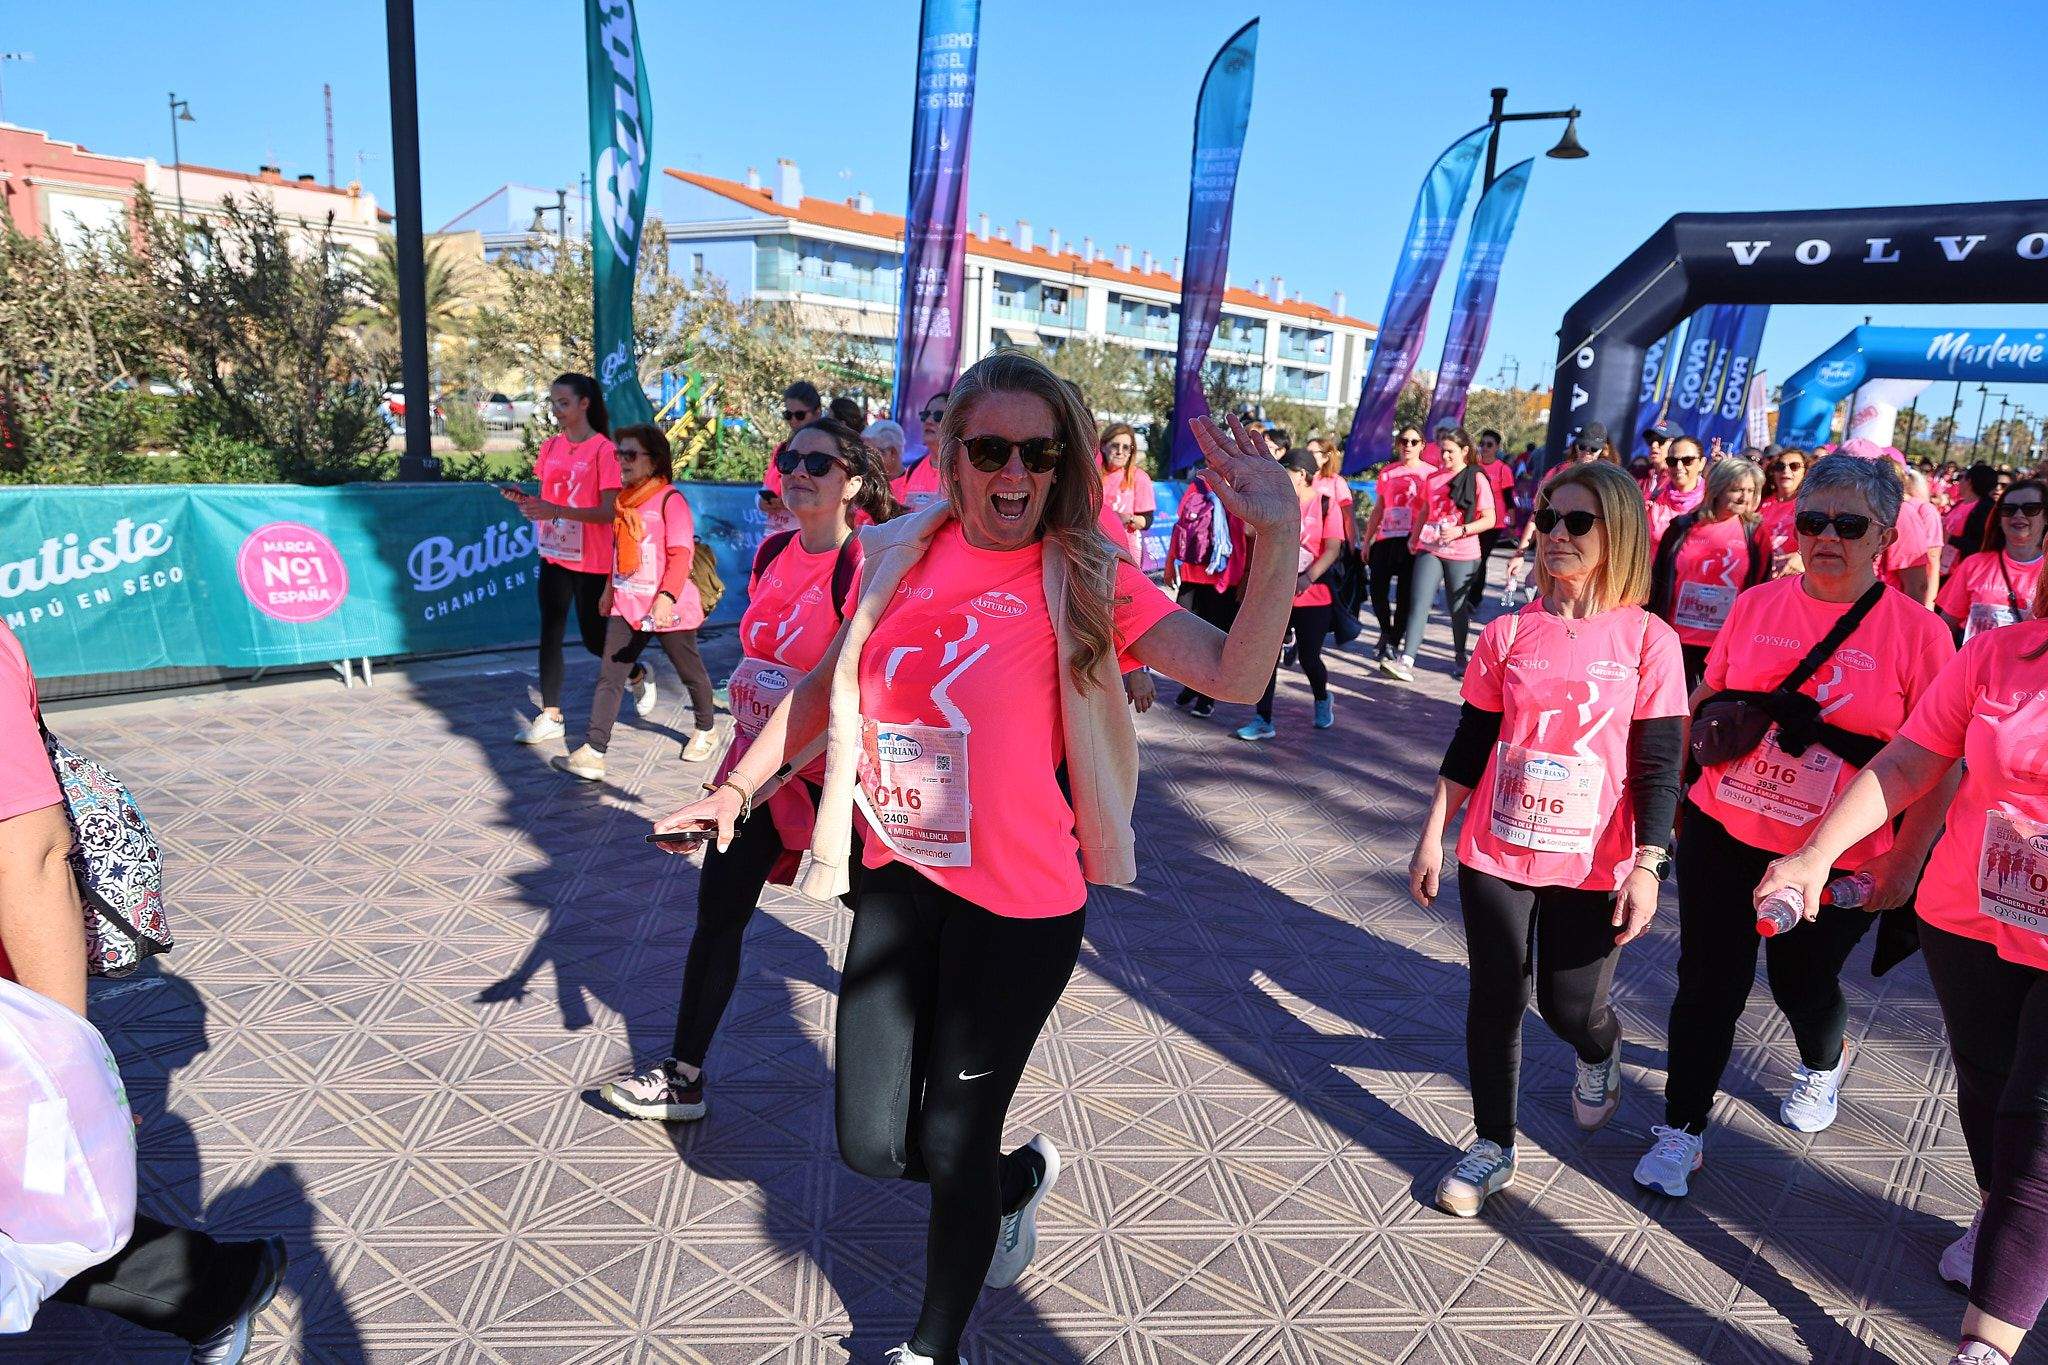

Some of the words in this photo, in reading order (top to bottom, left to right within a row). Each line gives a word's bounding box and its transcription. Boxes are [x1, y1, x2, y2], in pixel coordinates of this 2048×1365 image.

[1726, 232, 2048, 266] VOLVO
[262, 541, 317, 553] MARCA
[0, 518, 173, 598] atiste
[407, 520, 539, 592] Batis
[7, 598, 64, 630] MPÚ
[77, 587, 112, 609] EN
[123, 566, 184, 596] SECO
[268, 586, 332, 605] ESPAÑA
[424, 579, 498, 620] CHAMPÚ
[504, 571, 526, 590] EN
[972, 597, 1023, 615] ASTURIANA
[1753, 634, 1800, 650] OYSHO
[878, 746, 919, 757] STURIANA
[1525, 764, 1567, 778] ASTURIANA
[1754, 760, 1798, 784] 016
[1756, 780, 1778, 792] 3936
[875, 785, 922, 810] 016
[1521, 794, 1565, 814] 016
[1724, 789, 1753, 804] OYSHO
[883, 814, 909, 824] 2409
[1527, 814, 1549, 824] 4135
[893, 827, 914, 837] MUJER
[918, 831, 949, 841] VALENCIA
[1497, 824, 1526, 840] OYSHO
[910, 846, 952, 859] Santander
[1996, 896, 2025, 910] CARRERA
[1995, 905, 2038, 926] OYSHO
